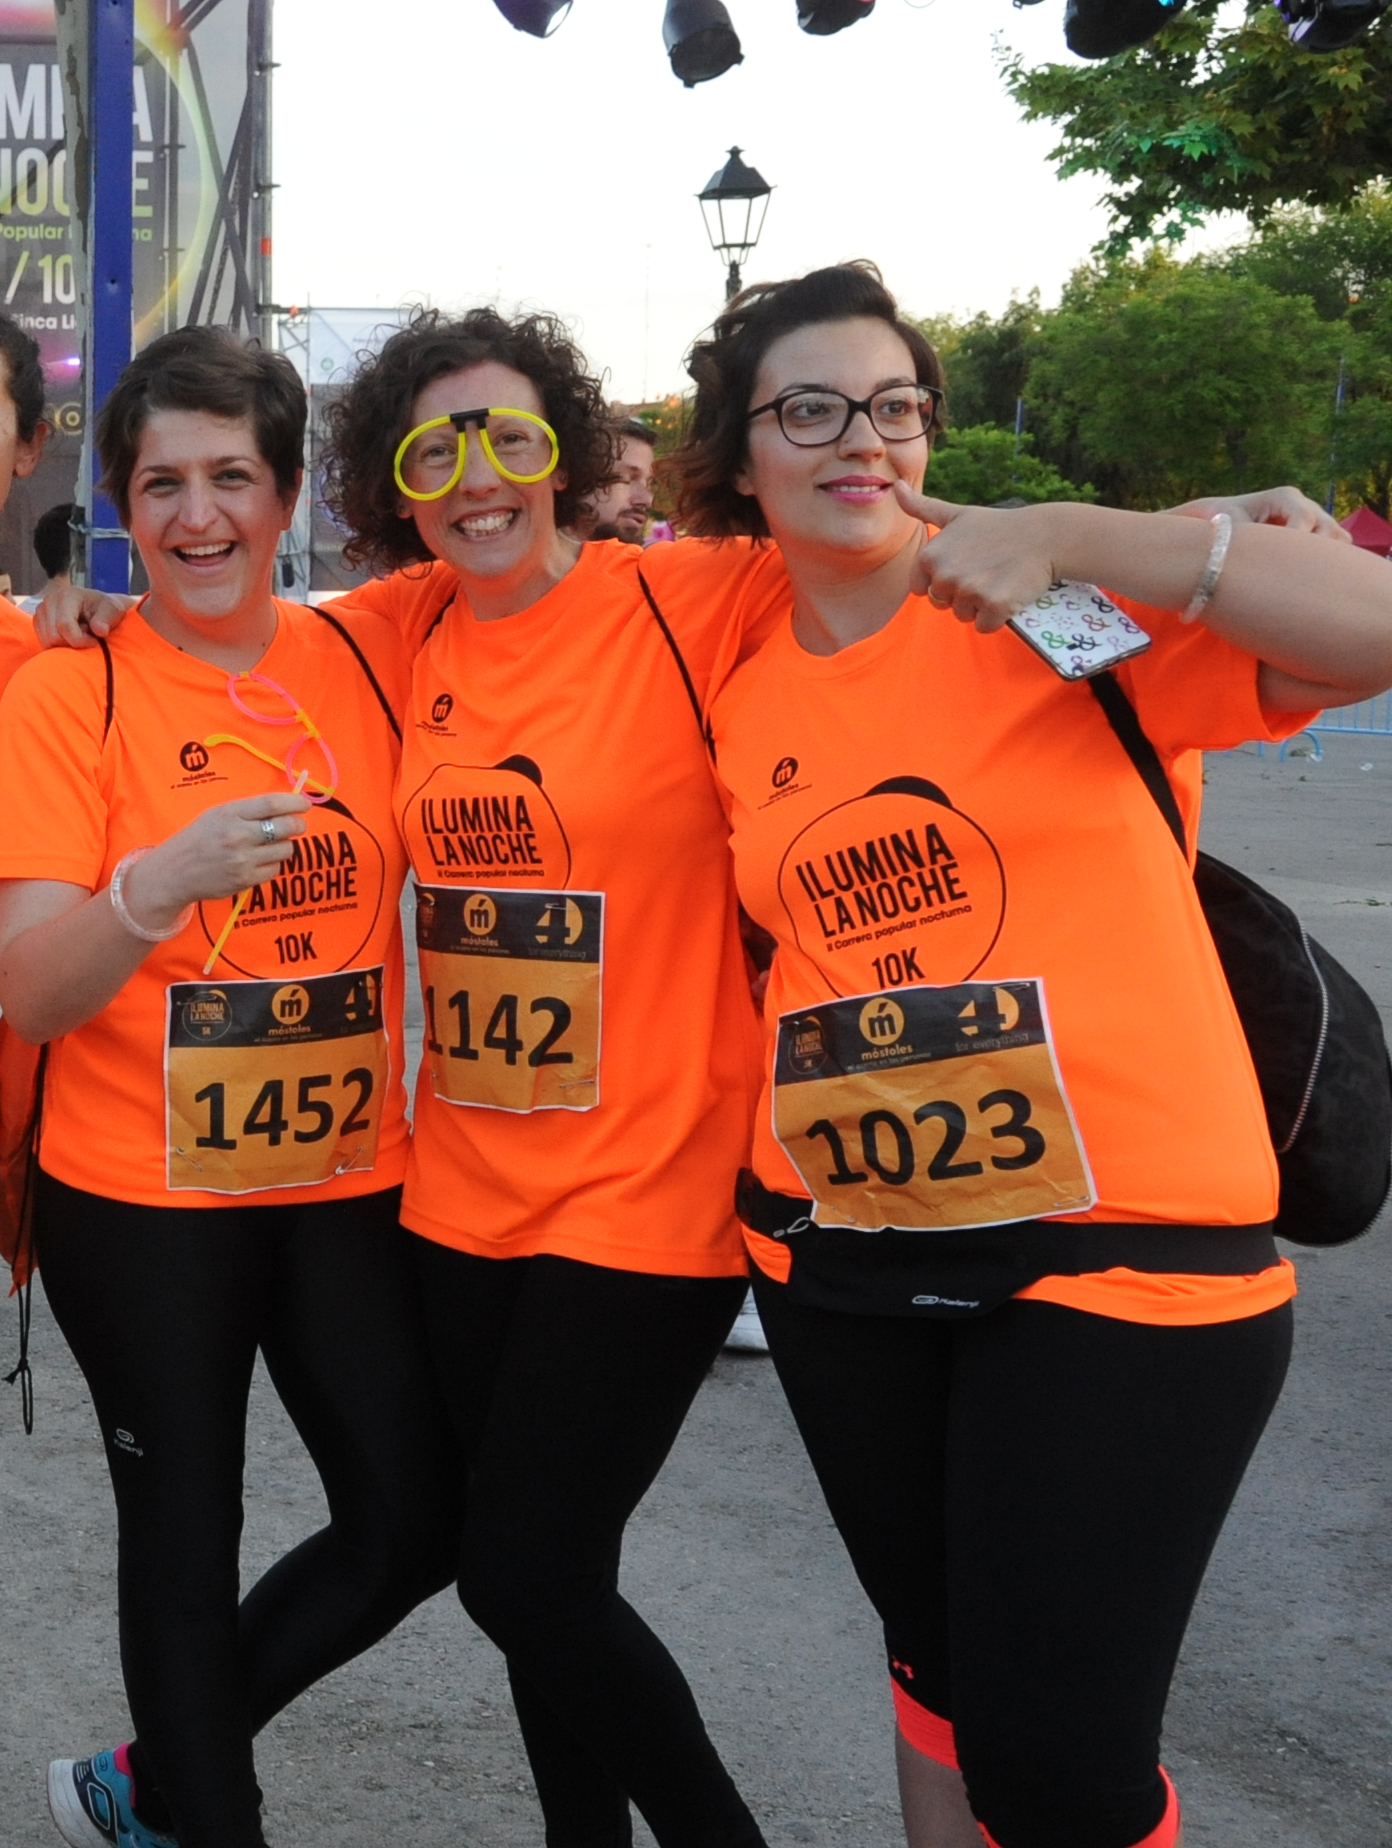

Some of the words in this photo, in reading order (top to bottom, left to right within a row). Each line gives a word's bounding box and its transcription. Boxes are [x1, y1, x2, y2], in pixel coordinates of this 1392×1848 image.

[421, 795, 534, 835] ILUMINA
[795, 822, 955, 902] ILUMINA
[242, 914, 277, 928] Carrera
[280, 908, 315, 922] popular
[834, 934, 873, 950] Carrera
[874, 918, 917, 940] popular
[274, 931, 318, 964] 10K
[871, 946, 926, 989] 10K
[268, 1024, 312, 1037] móstoles
[426, 985, 574, 1068] 1142
[861, 1044, 914, 1060] móstoles
[194, 1067, 374, 1150] 1452
[805, 1088, 1046, 1186] 1023
